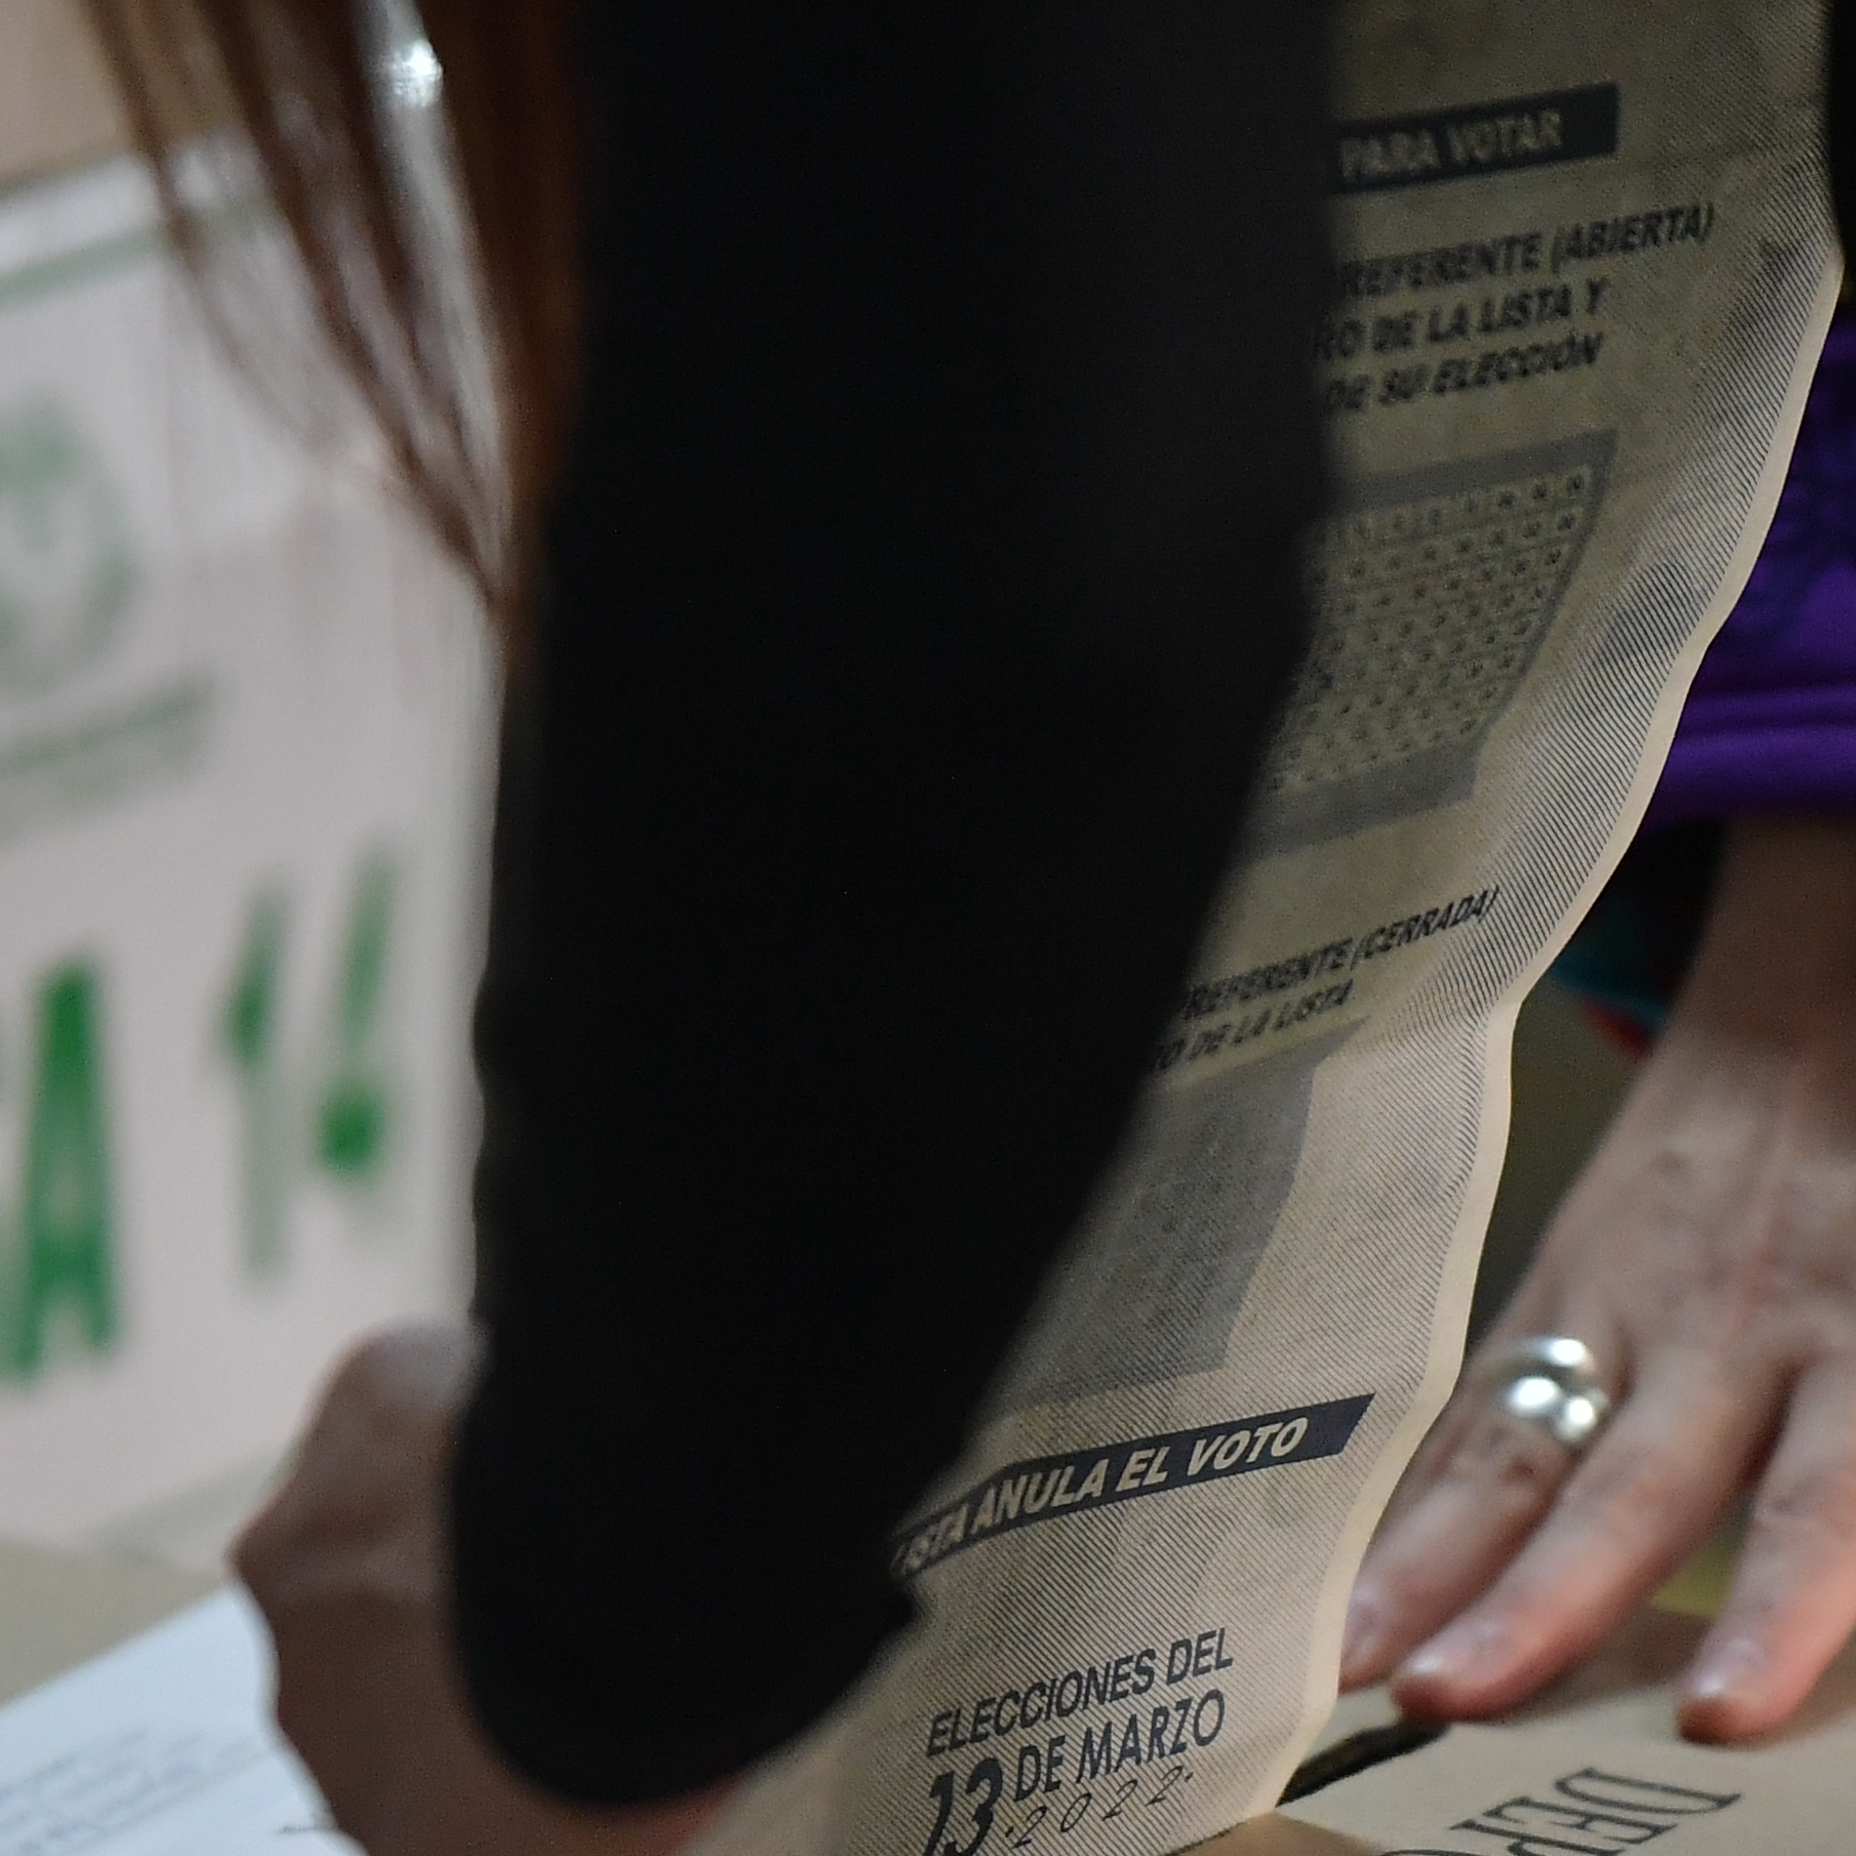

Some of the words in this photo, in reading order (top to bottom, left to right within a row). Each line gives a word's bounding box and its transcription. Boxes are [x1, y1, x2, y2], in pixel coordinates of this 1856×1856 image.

[1446, 107, 1564, 166] VOTAR
[1342, 231, 1542, 297] REFERENTE
[1548, 200, 1715, 274] (ABIERTA)
[1425, 300, 1471, 344] LA
[1477, 283, 1573, 335] LISTA
[1585, 276, 1611, 316] Y
[1183, 936, 1354, 1020] REFERENTE
[1350, 885, 1500, 970] (CERRADA)
[212, 842, 406, 1290] 14
[970, 1463, 1110, 1536] ANULA
[1115, 1446, 1170, 1493] EL
[1185, 1415, 1310, 1477] VOTO
[926, 1646, 1156, 1759] ELECCIONES
[1165, 1626, 1235, 1685] DEL
[1013, 1732, 1067, 1802] DE
[1075, 1687, 1227, 1787] MARZO
